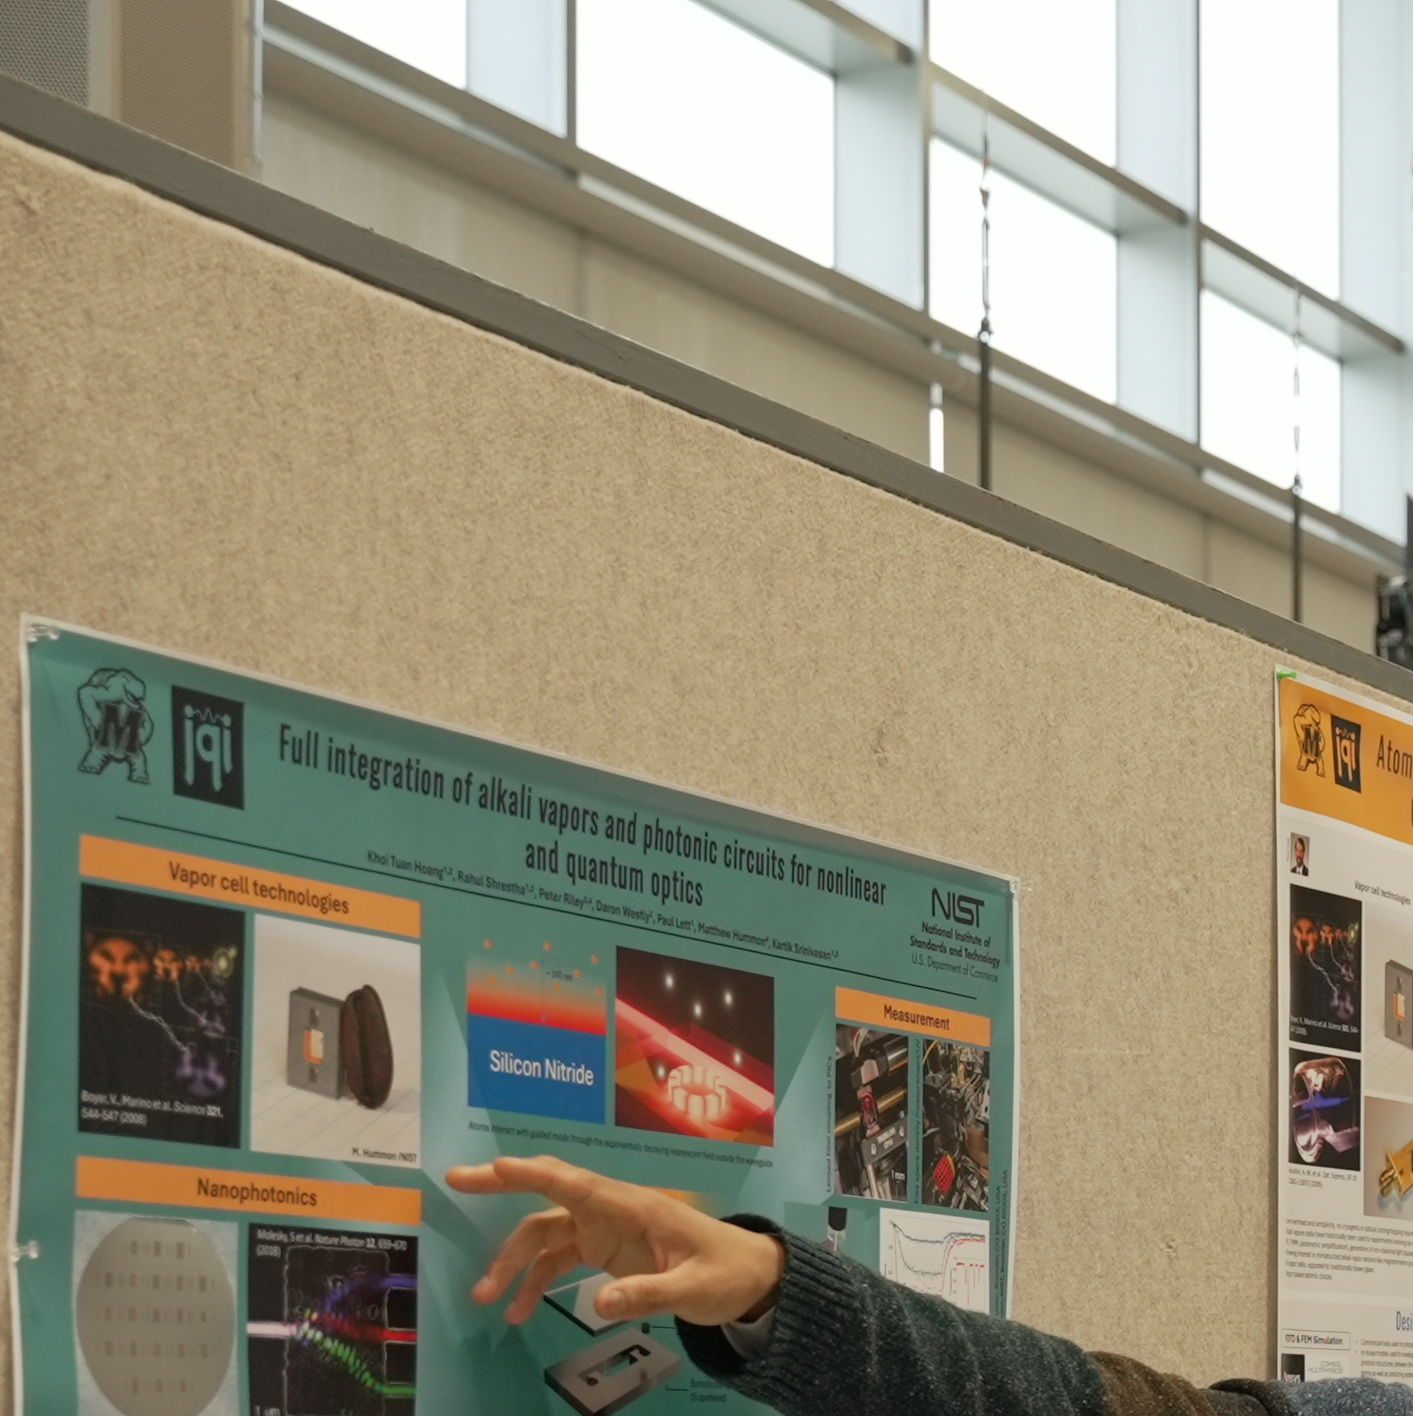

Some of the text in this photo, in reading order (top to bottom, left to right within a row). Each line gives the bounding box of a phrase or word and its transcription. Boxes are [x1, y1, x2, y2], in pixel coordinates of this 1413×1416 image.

[183, 704, 233, 792] jqi
[1335, 726, 1356, 782] jqi
[279, 723, 887, 906] Full integration of alkali vapors and photonic circuits for nonlinear
[169, 861, 349, 915] Vapor cell technologies
[525, 843, 703, 907] and quantum optics
[391, 855, 412, 870] Tuan
[458, 870, 484, 886] Rahul
[539, 887, 562, 902] Peter
[596, 900, 621, 915] Daron
[657, 913, 674, 927] Paul
[698, 922, 731, 938] Matthew
[772, 939, 793, 952] Kartik
[931, 887, 985, 928] NIST
[1355, 881, 1411, 905] Vapor cell technologies
[922, 921, 991, 948] National Institute of
[910, 935, 1000, 969] Standards and Technology
[912, 953, 998, 983] U.S. Department of Commerce
[884, 1004, 949, 1030] Measurement
[490, 1049, 594, 1086] Silicon Nitride
[119, 1095, 152, 1109] Marino
[151, 1101, 161, 1110] et
[174, 1101, 206, 1115] Science
[197, 1178, 317, 1207] Nanophotonics
[1313, 1335, 1343, 1345] Simulation
[256, 1406, 260, 1416] 1
